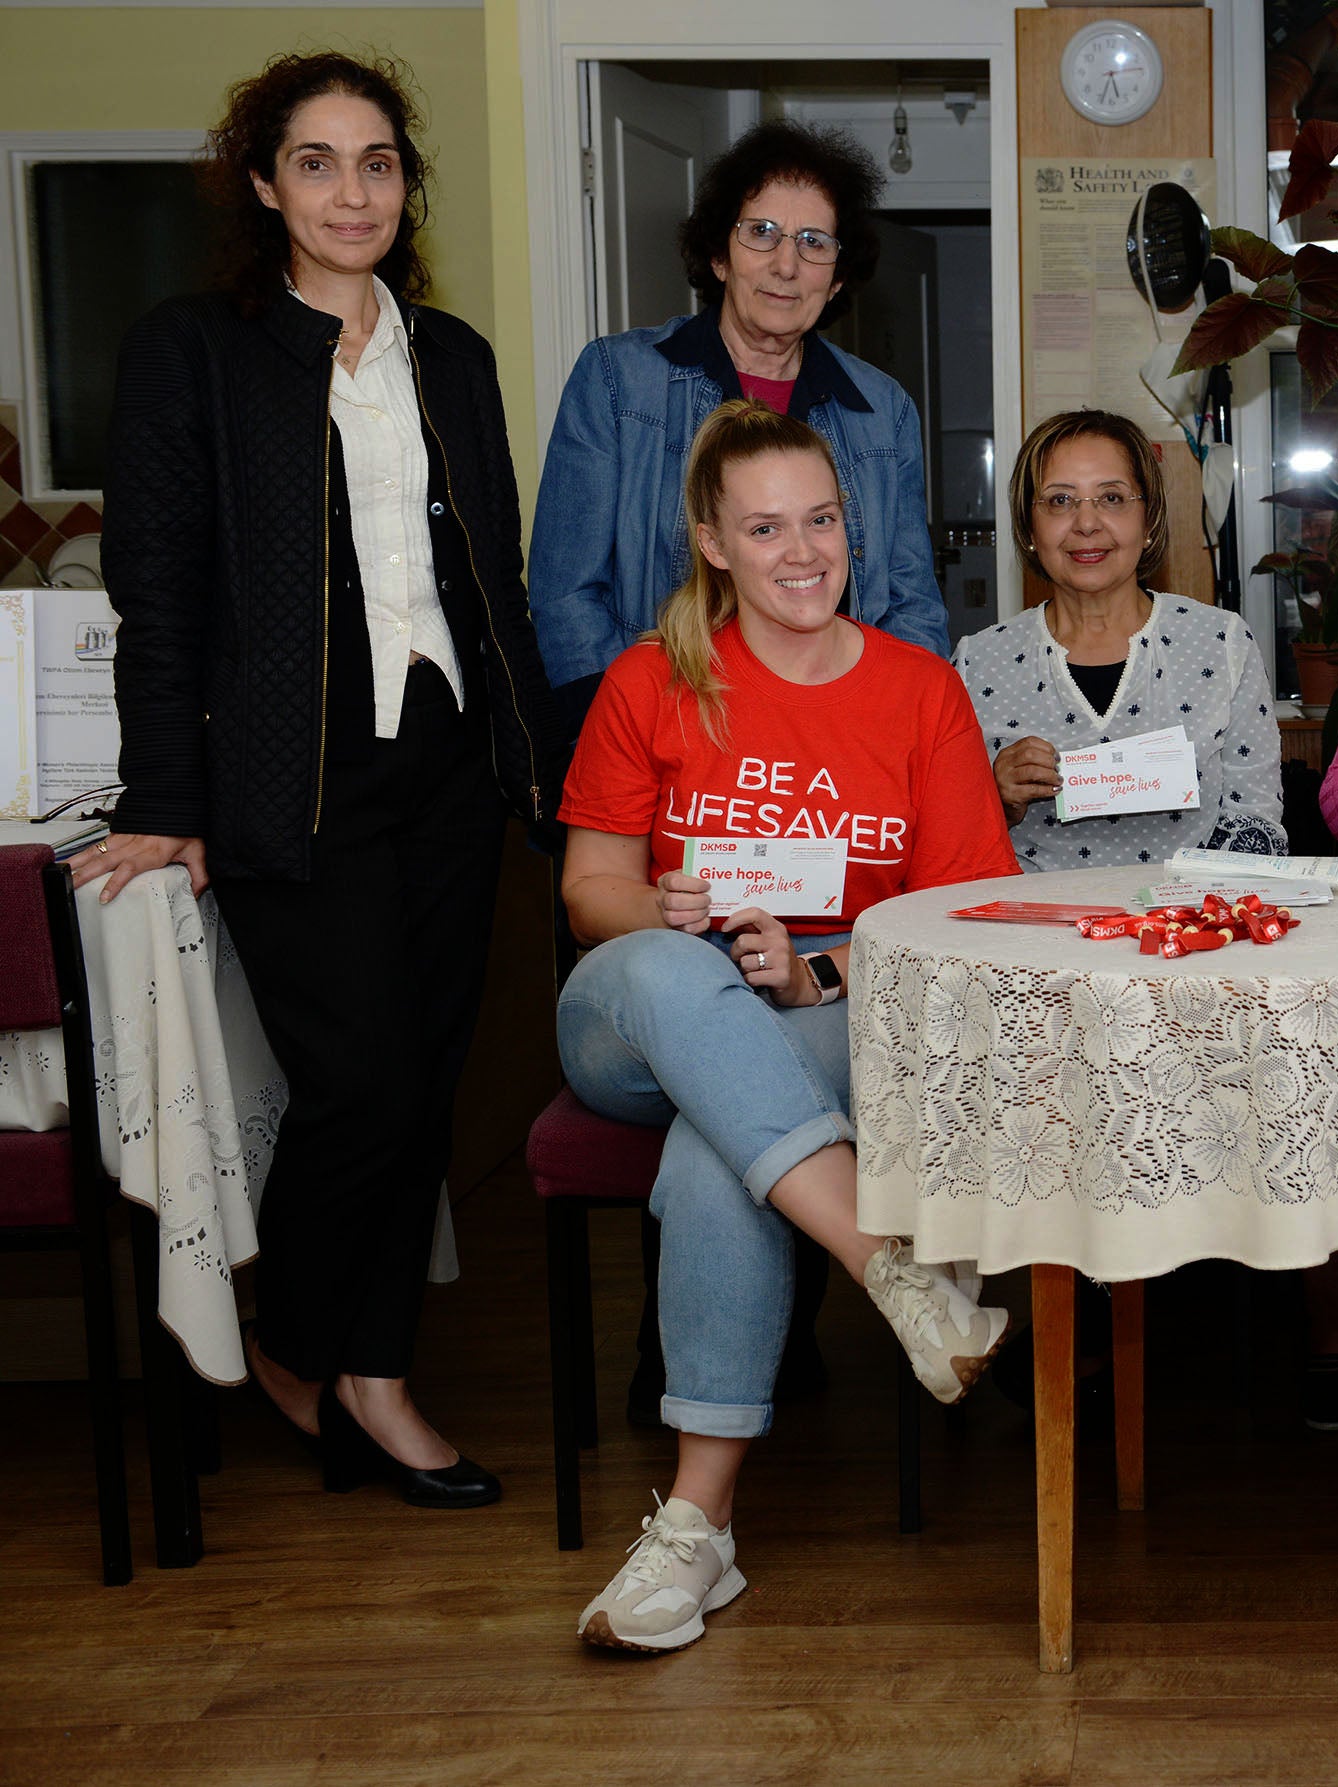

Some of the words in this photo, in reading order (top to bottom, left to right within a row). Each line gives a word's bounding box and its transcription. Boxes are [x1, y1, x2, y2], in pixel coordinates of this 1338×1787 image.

[1069, 166, 1132, 180] HEALTH
[1136, 168, 1170, 179] AND
[1072, 180, 1130, 193] SAFETY
[1065, 754, 1089, 763] DKMS
[736, 757, 796, 796] BE
[806, 767, 840, 800] A
[1068, 774, 1097, 786] Give
[1100, 773, 1135, 785] hope,
[1109, 782, 1137, 798] save
[666, 786, 908, 851] LIFESAVER
[700, 843, 729, 852] DKMS
[699, 867, 733, 880] Give
[736, 867, 775, 883] hope,
[743, 882, 776, 898] save
[1092, 924, 1126, 938] DKMS
